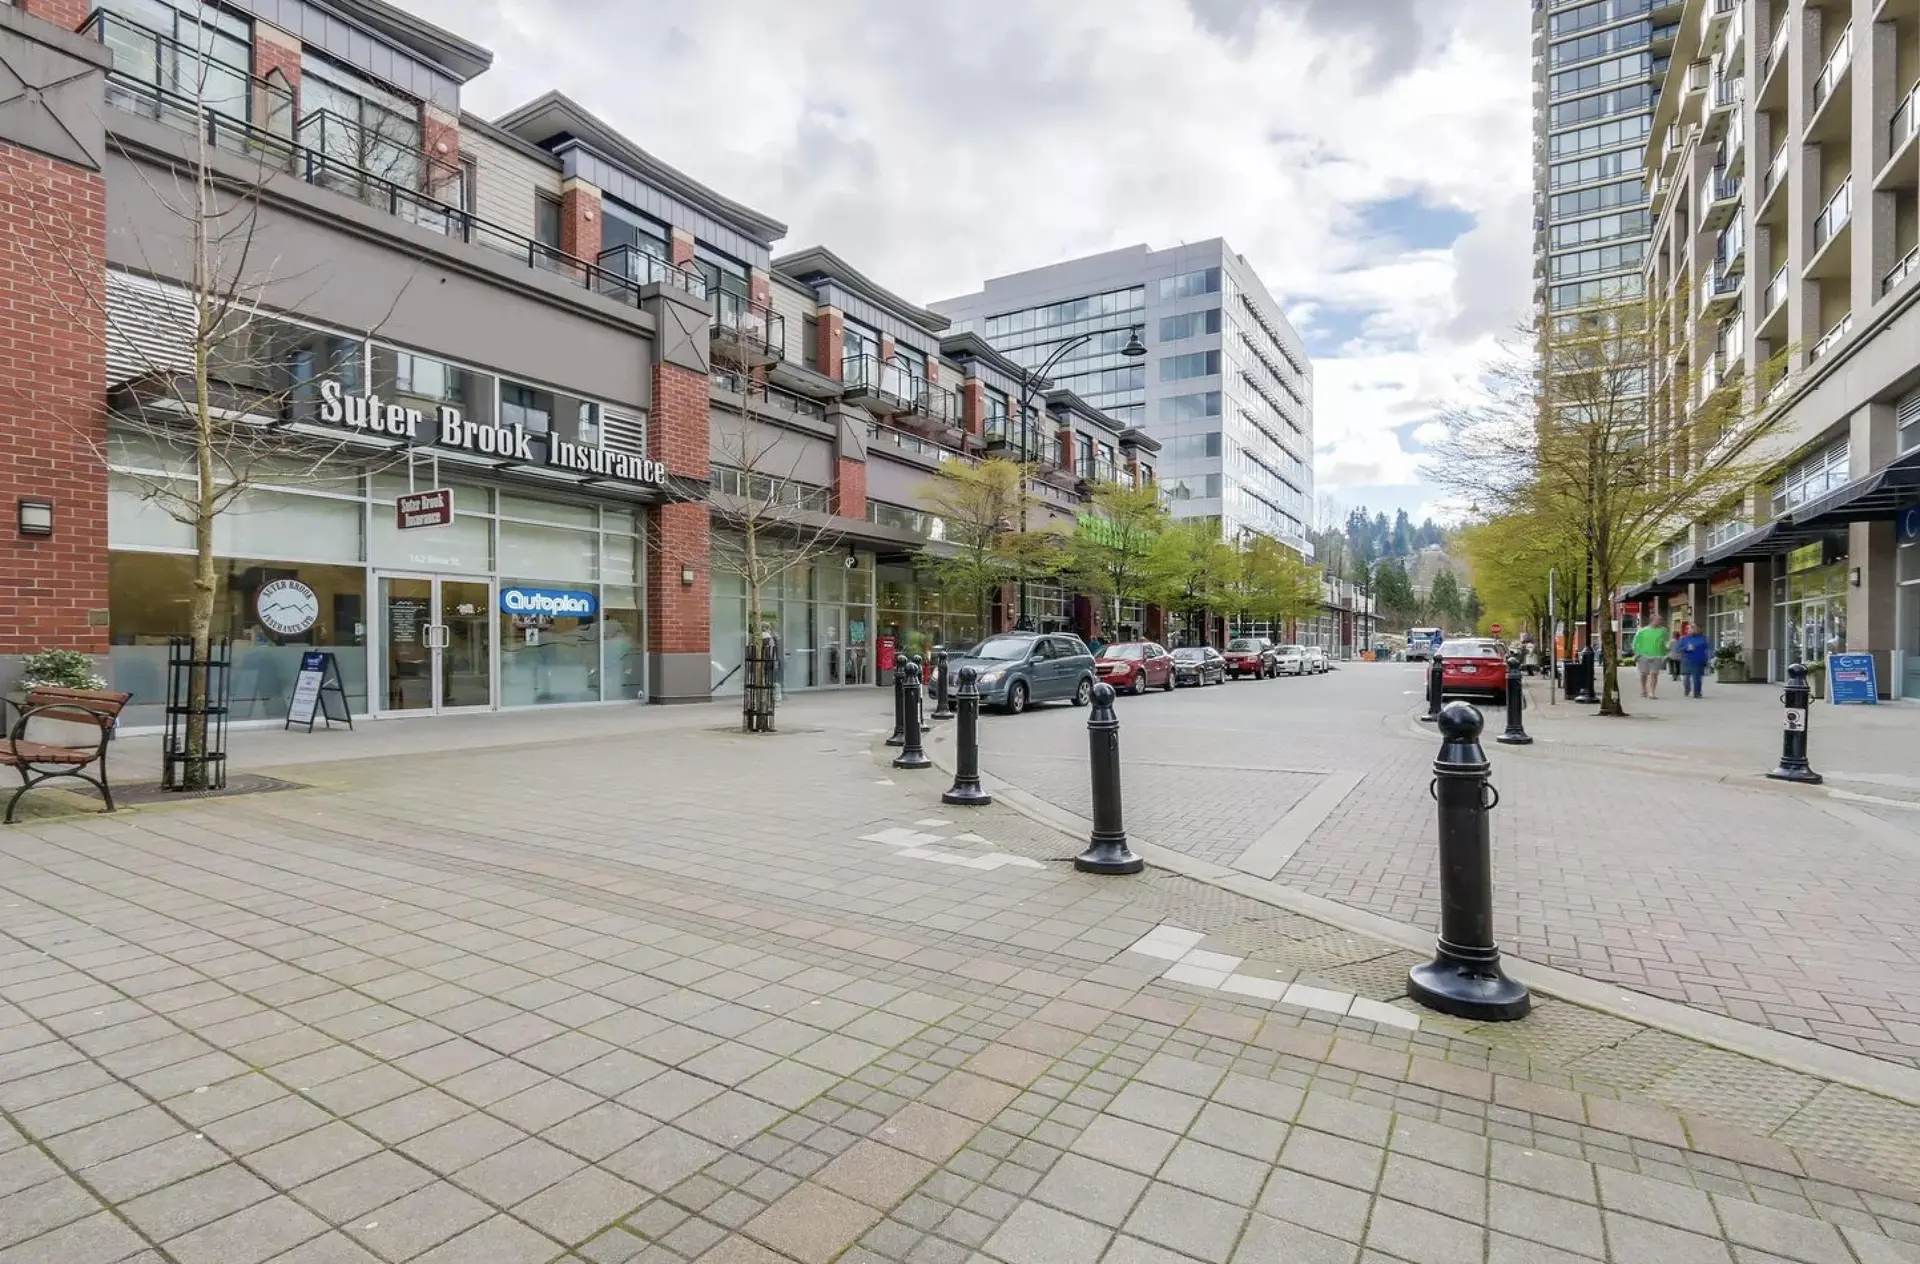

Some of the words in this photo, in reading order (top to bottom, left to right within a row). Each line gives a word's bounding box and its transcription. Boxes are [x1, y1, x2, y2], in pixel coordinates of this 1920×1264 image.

[320, 379, 422, 438] Suter
[439, 405, 534, 460] Brook
[549, 430, 666, 484] Insurance
[401, 498, 421, 513] Suter
[421, 493, 445, 510] Brook
[405, 511, 441, 528] Insurance
[505, 590, 590, 615] Autoplan
